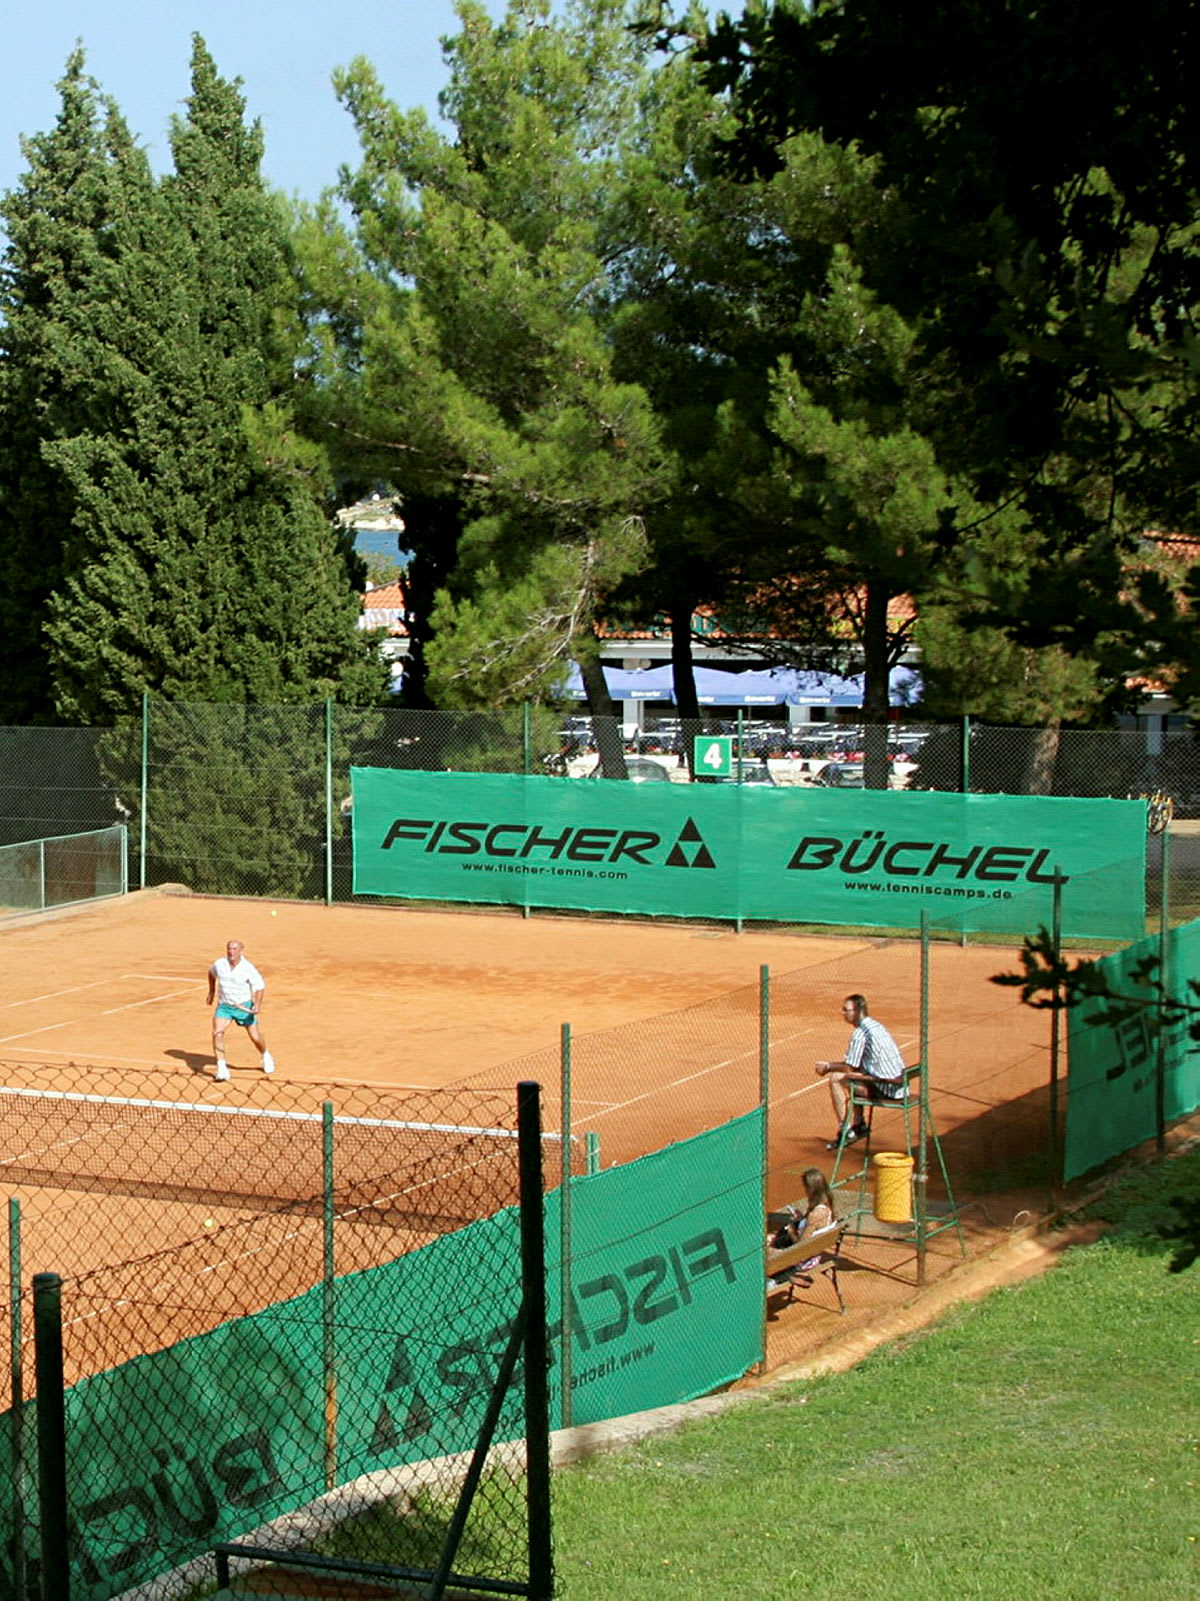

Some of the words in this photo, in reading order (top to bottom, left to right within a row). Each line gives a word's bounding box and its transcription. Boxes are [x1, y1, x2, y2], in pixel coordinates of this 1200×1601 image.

[703, 743, 723, 769] 4
[381, 819, 661, 864] FISCHER
[786, 831, 1070, 884] BÜCHEL
[462, 862, 628, 880] www.fischer-tennis.com
[845, 880, 1013, 900] www.tenniscamps.de
